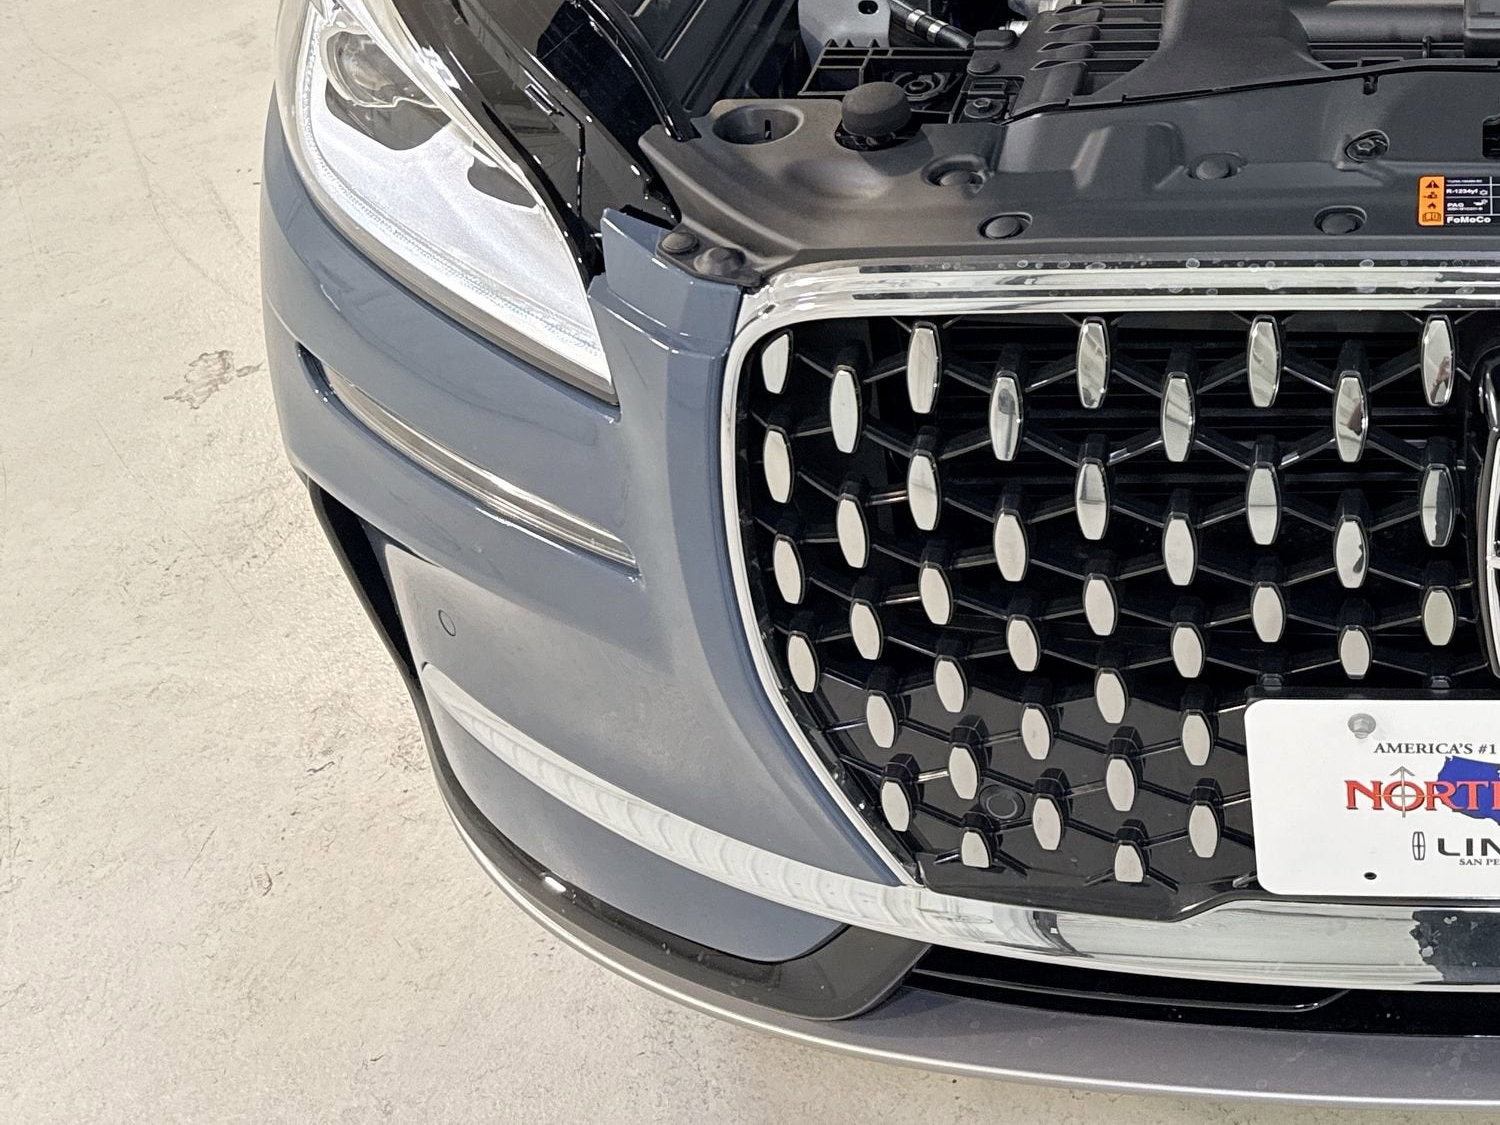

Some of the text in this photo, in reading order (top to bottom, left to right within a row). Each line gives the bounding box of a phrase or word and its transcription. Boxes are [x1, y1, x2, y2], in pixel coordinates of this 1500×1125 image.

[1373, 742, 1473, 755] AMERICA'S
[1478, 743, 1497, 755] #1
[1458, 858, 1482, 866] SAN
